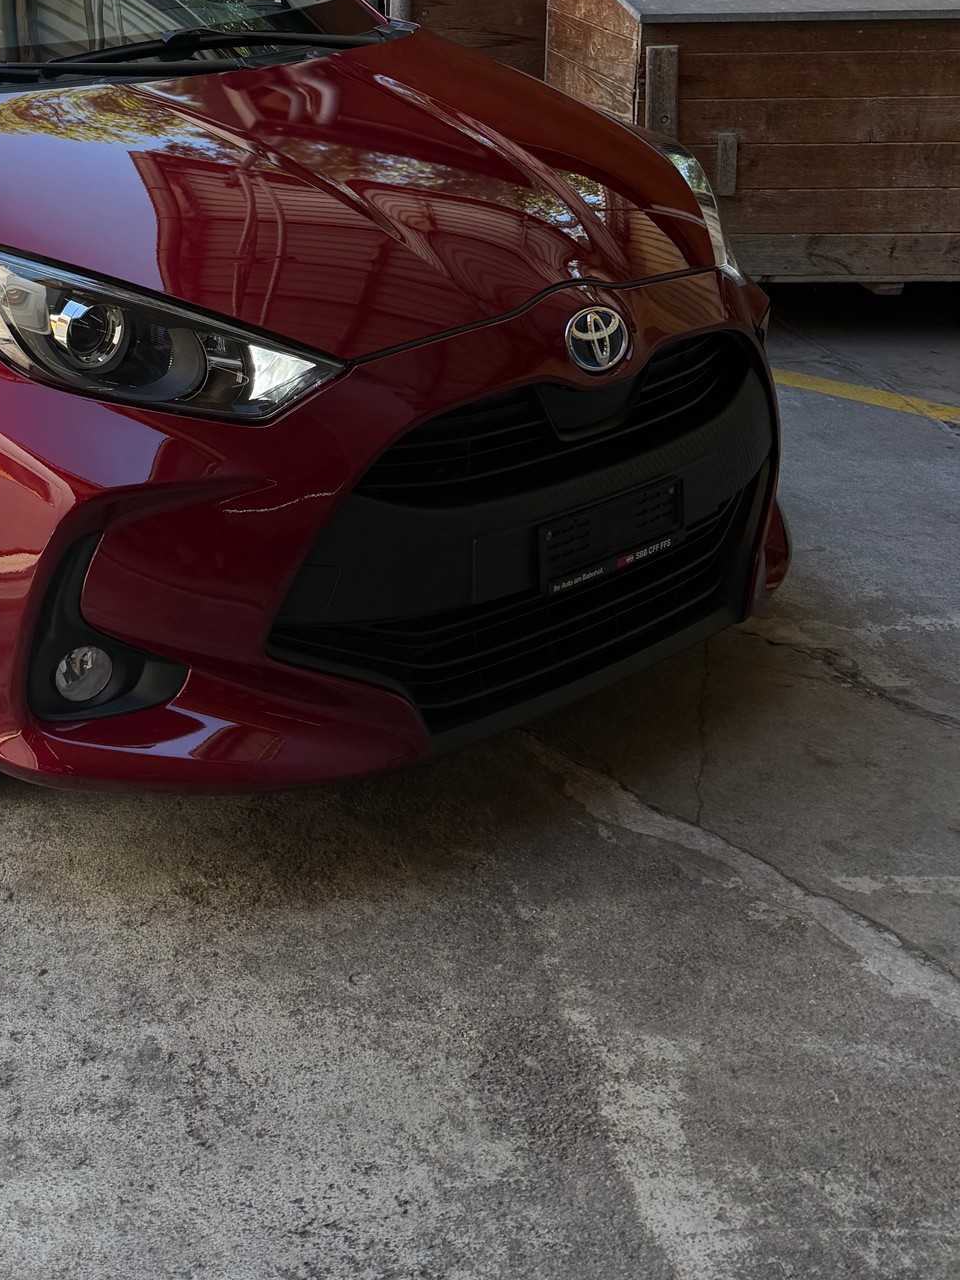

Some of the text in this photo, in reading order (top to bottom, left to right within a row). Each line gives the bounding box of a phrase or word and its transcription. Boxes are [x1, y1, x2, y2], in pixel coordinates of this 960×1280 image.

[635, 538, 672, 560] SBB CFF FFS
